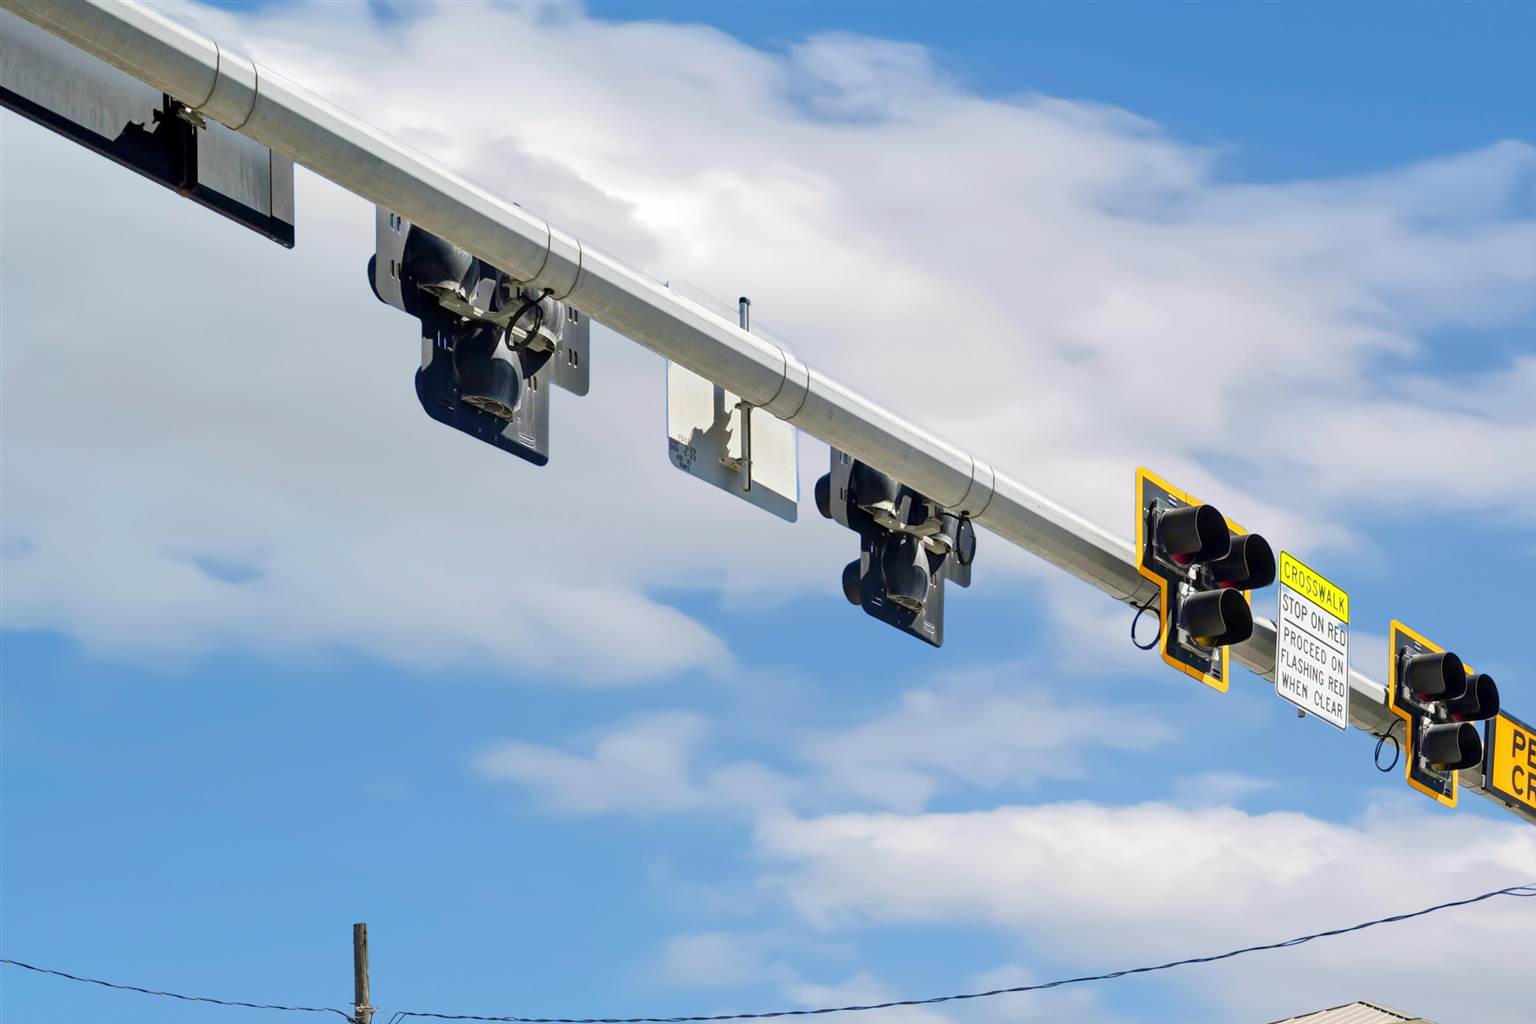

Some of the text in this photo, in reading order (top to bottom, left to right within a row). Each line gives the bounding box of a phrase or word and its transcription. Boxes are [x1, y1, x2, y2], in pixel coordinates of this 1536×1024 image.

[1284, 561, 1345, 615] CROSSWALK
[1282, 593, 1346, 647] STOP ON RED
[1281, 649, 1345, 698] FLASHING RED
[1283, 626, 1344, 675] PROCEED ON
[1282, 671, 1343, 719] WHEN CLEAR
